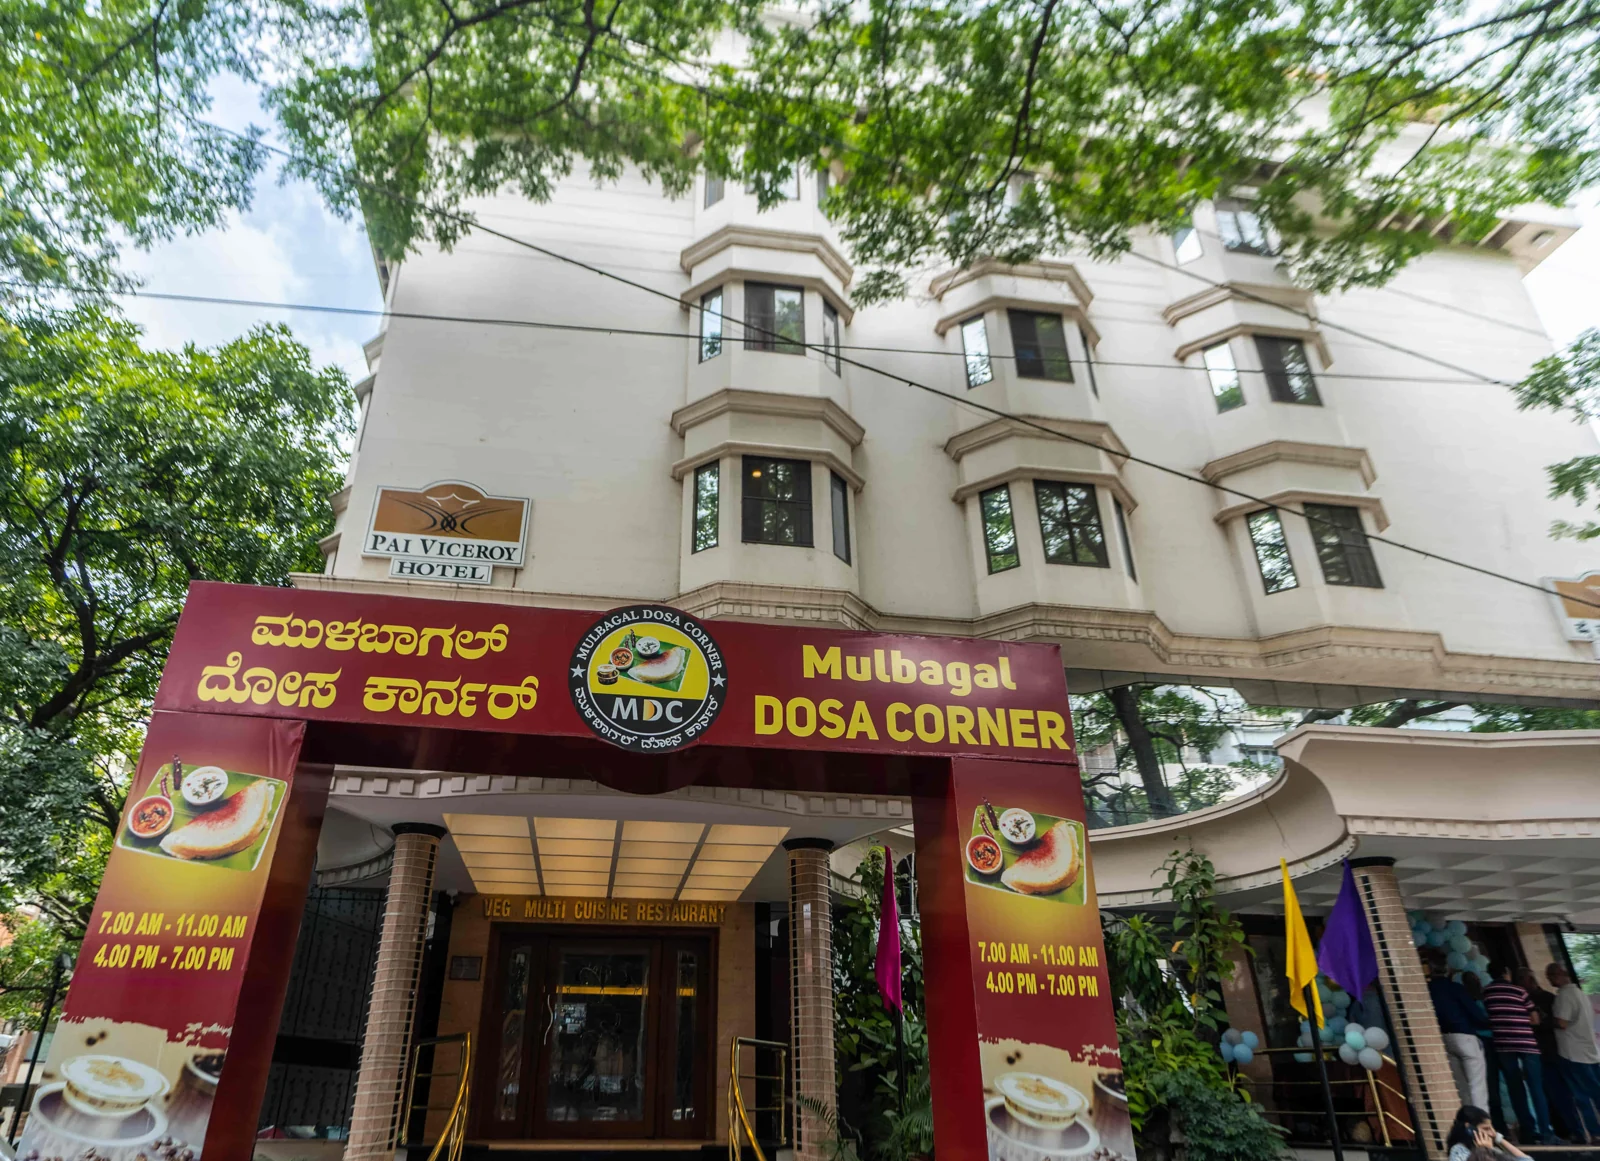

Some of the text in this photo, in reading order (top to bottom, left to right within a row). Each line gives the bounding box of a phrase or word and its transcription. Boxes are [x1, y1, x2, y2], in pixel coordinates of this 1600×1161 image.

[370, 534, 518, 562] PAI VICEROY
[397, 561, 485, 580] HOTEL
[251, 611, 509, 660] ಮುಳಬಾಗಲ್
[576, 609, 723, 671] MULBAGAL DOSA CORNER
[802, 644, 1017, 697] Mulbagal
[363, 675, 539, 720] ಕಾರ್ನರ್
[611, 697, 683, 723] MDC
[754, 694, 1071, 750] DOSA CORNER
[484, 898, 727, 923] VEG MULTI CUISINE RESTAURANT
[98, 911, 135, 935] 7.00
[134, 912, 165, 936] AM
[176, 913, 219, 938] 11.00
[218, 915, 248, 938] AM
[93, 944, 131, 968] 4.00
[130, 945, 161, 969] PM
[170, 946, 206, 970] 7.00
[207, 947, 235, 971] PM
[978, 941, 1006, 963] 7.00
[1010, 943, 1030, 964] AM
[1040, 944, 1075, 966] 11.00
[1078, 946, 1099, 967] AM
[986, 971, 1014, 994] 4.00
[1016, 972, 1038, 995] PM
[1047, 974, 1075, 996] 7.00
[1078, 975, 1099, 997] PM
